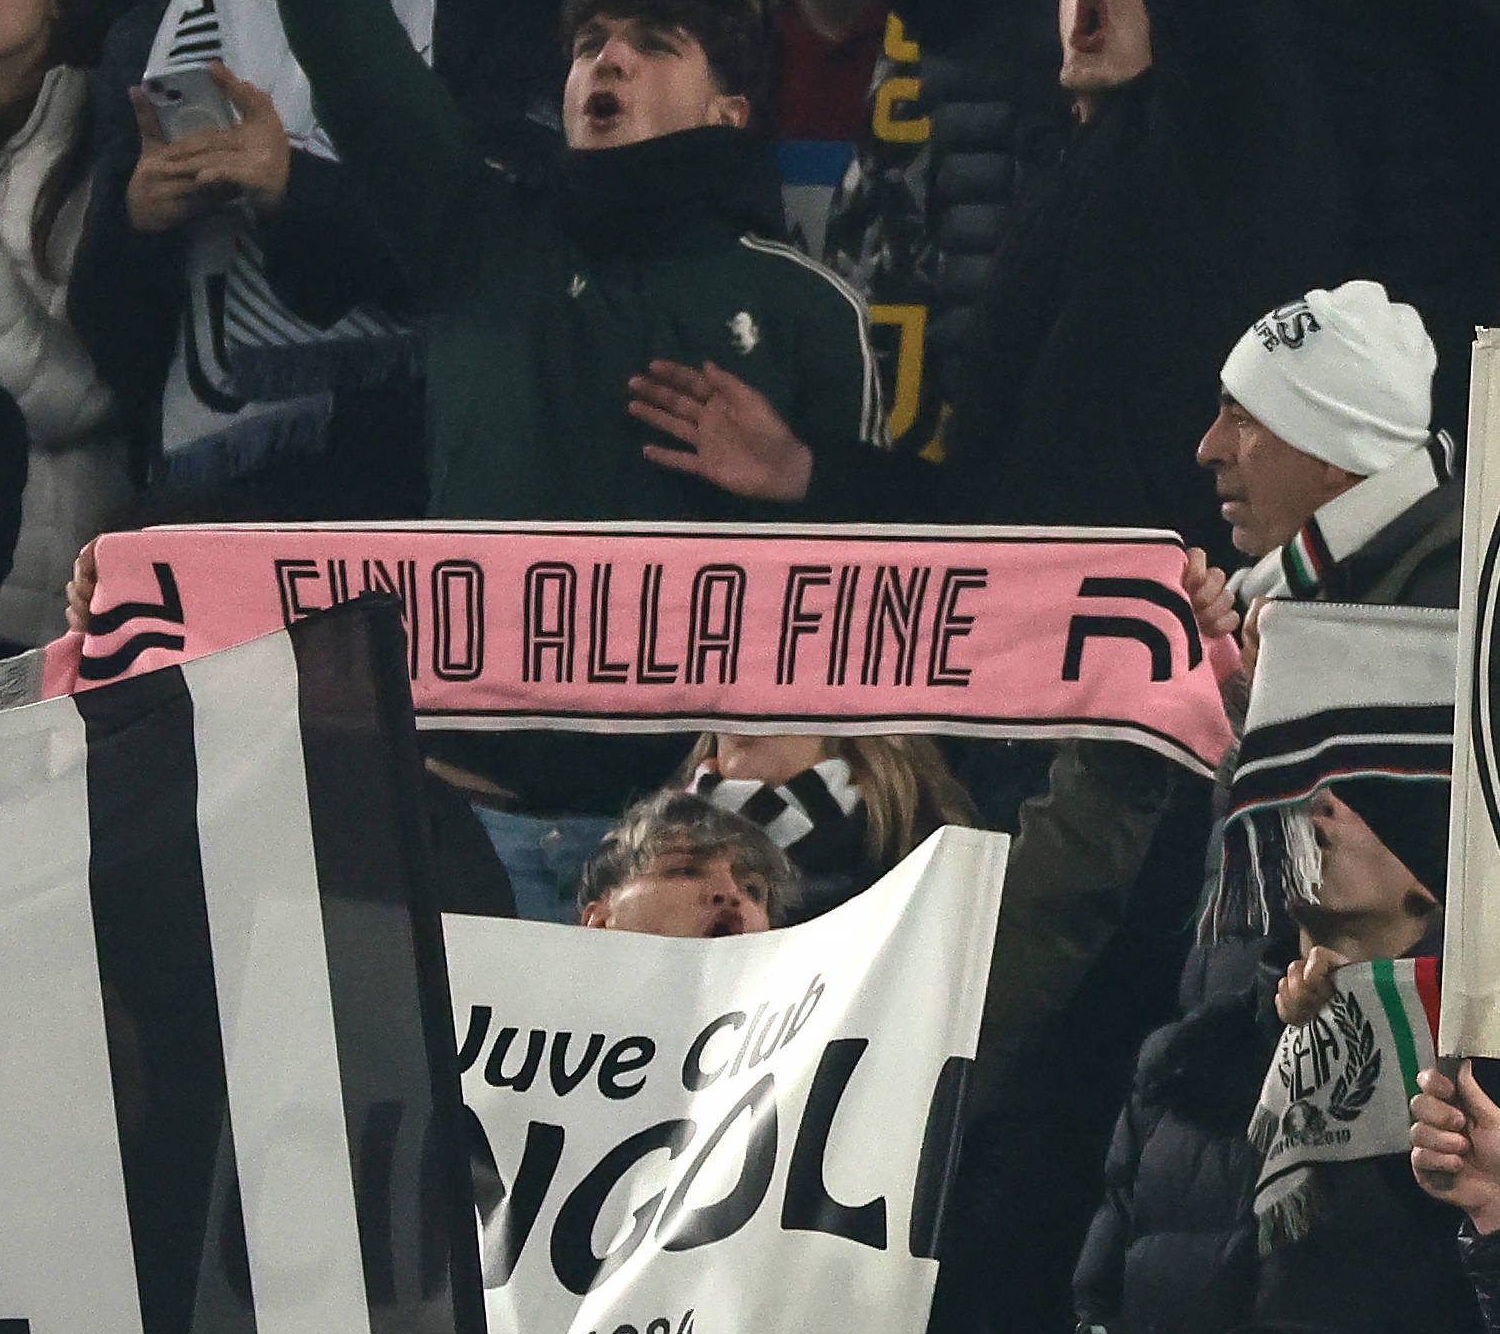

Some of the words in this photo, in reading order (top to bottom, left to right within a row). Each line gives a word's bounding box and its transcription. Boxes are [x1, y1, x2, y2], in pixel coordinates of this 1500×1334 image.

[522, 558, 746, 686] ALLA
[773, 561, 991, 688] FINE
[680, 972, 826, 1093] Club
